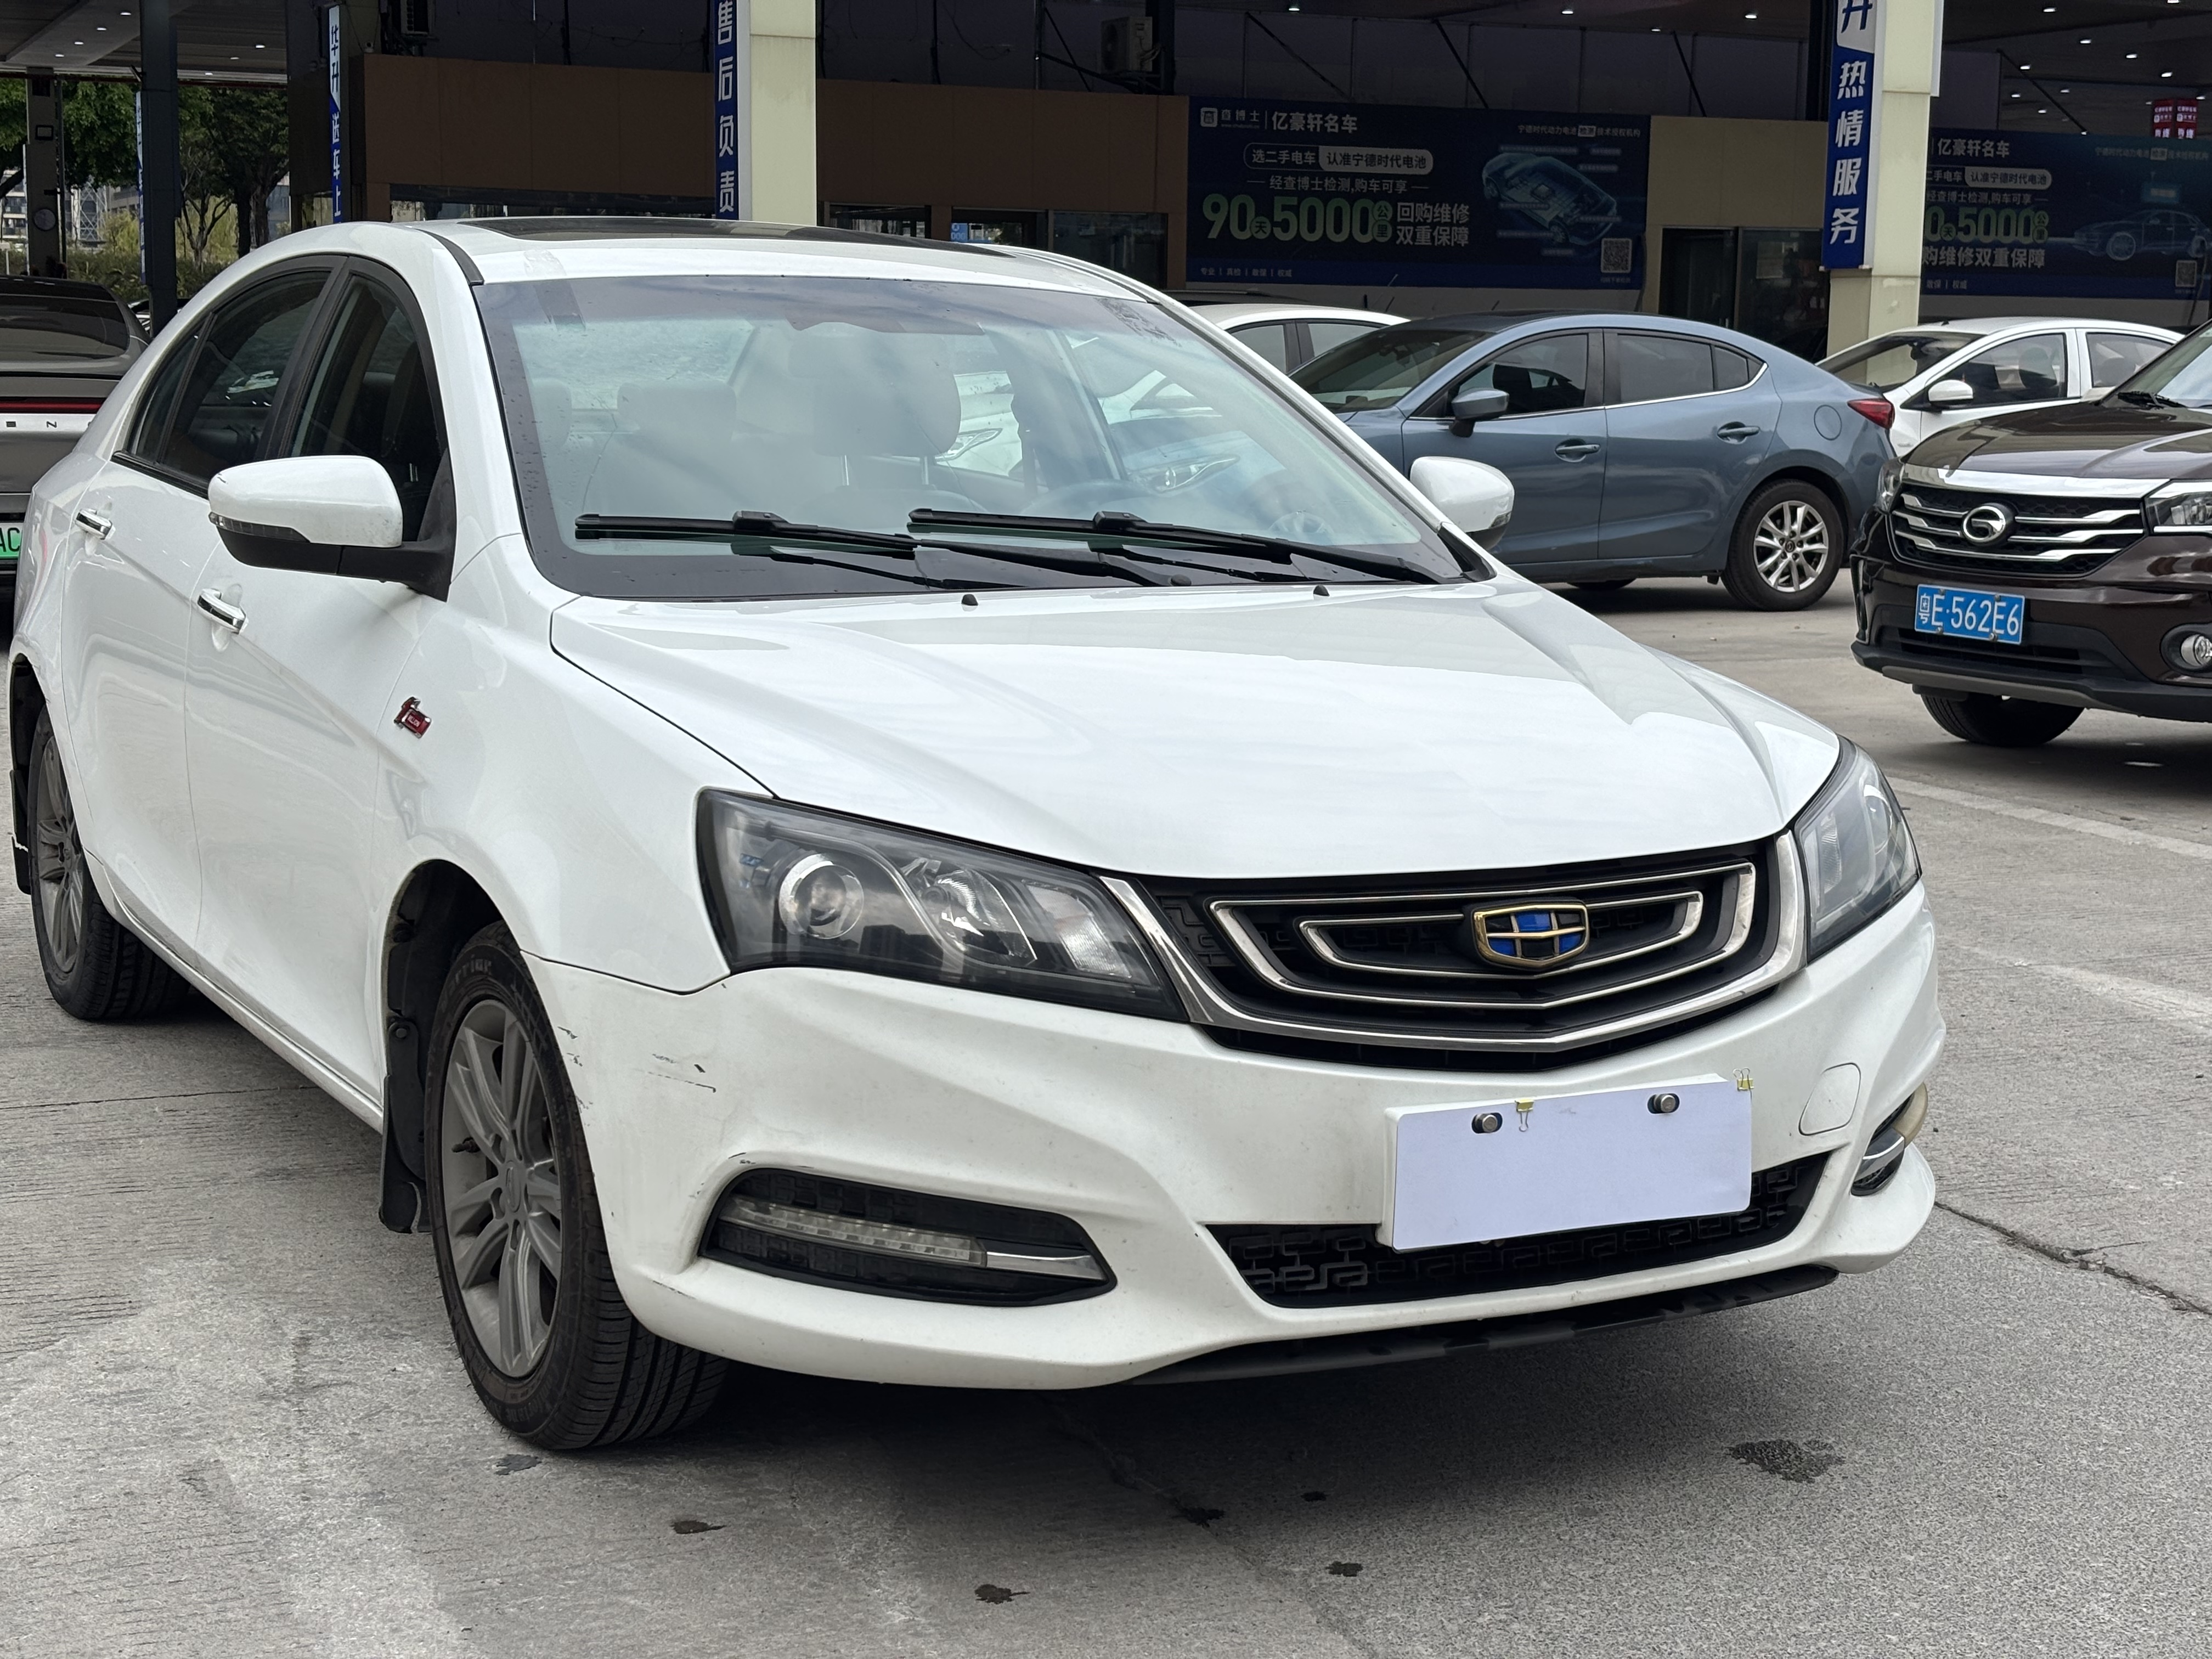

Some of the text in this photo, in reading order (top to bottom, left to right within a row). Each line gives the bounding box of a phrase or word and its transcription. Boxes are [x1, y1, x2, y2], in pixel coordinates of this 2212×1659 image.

[718, 0, 734, 213] 售后负责
[1221, 109, 1260, 122] 查博士
[1272, 111, 1358, 133] 亿豪轩名车
[1251, 148, 1426, 170] 选二手电车 认准宁德时代电池
[1830, 61, 1866, 244] 热情服务
[1938, 138, 2010, 158] 亿豪轩名车
[1971, 172, 2046, 185] 认准宁德时代电池
[1397, 202, 1470, 223] 回购维修
[1396, 225, 1470, 247] 双重保障
